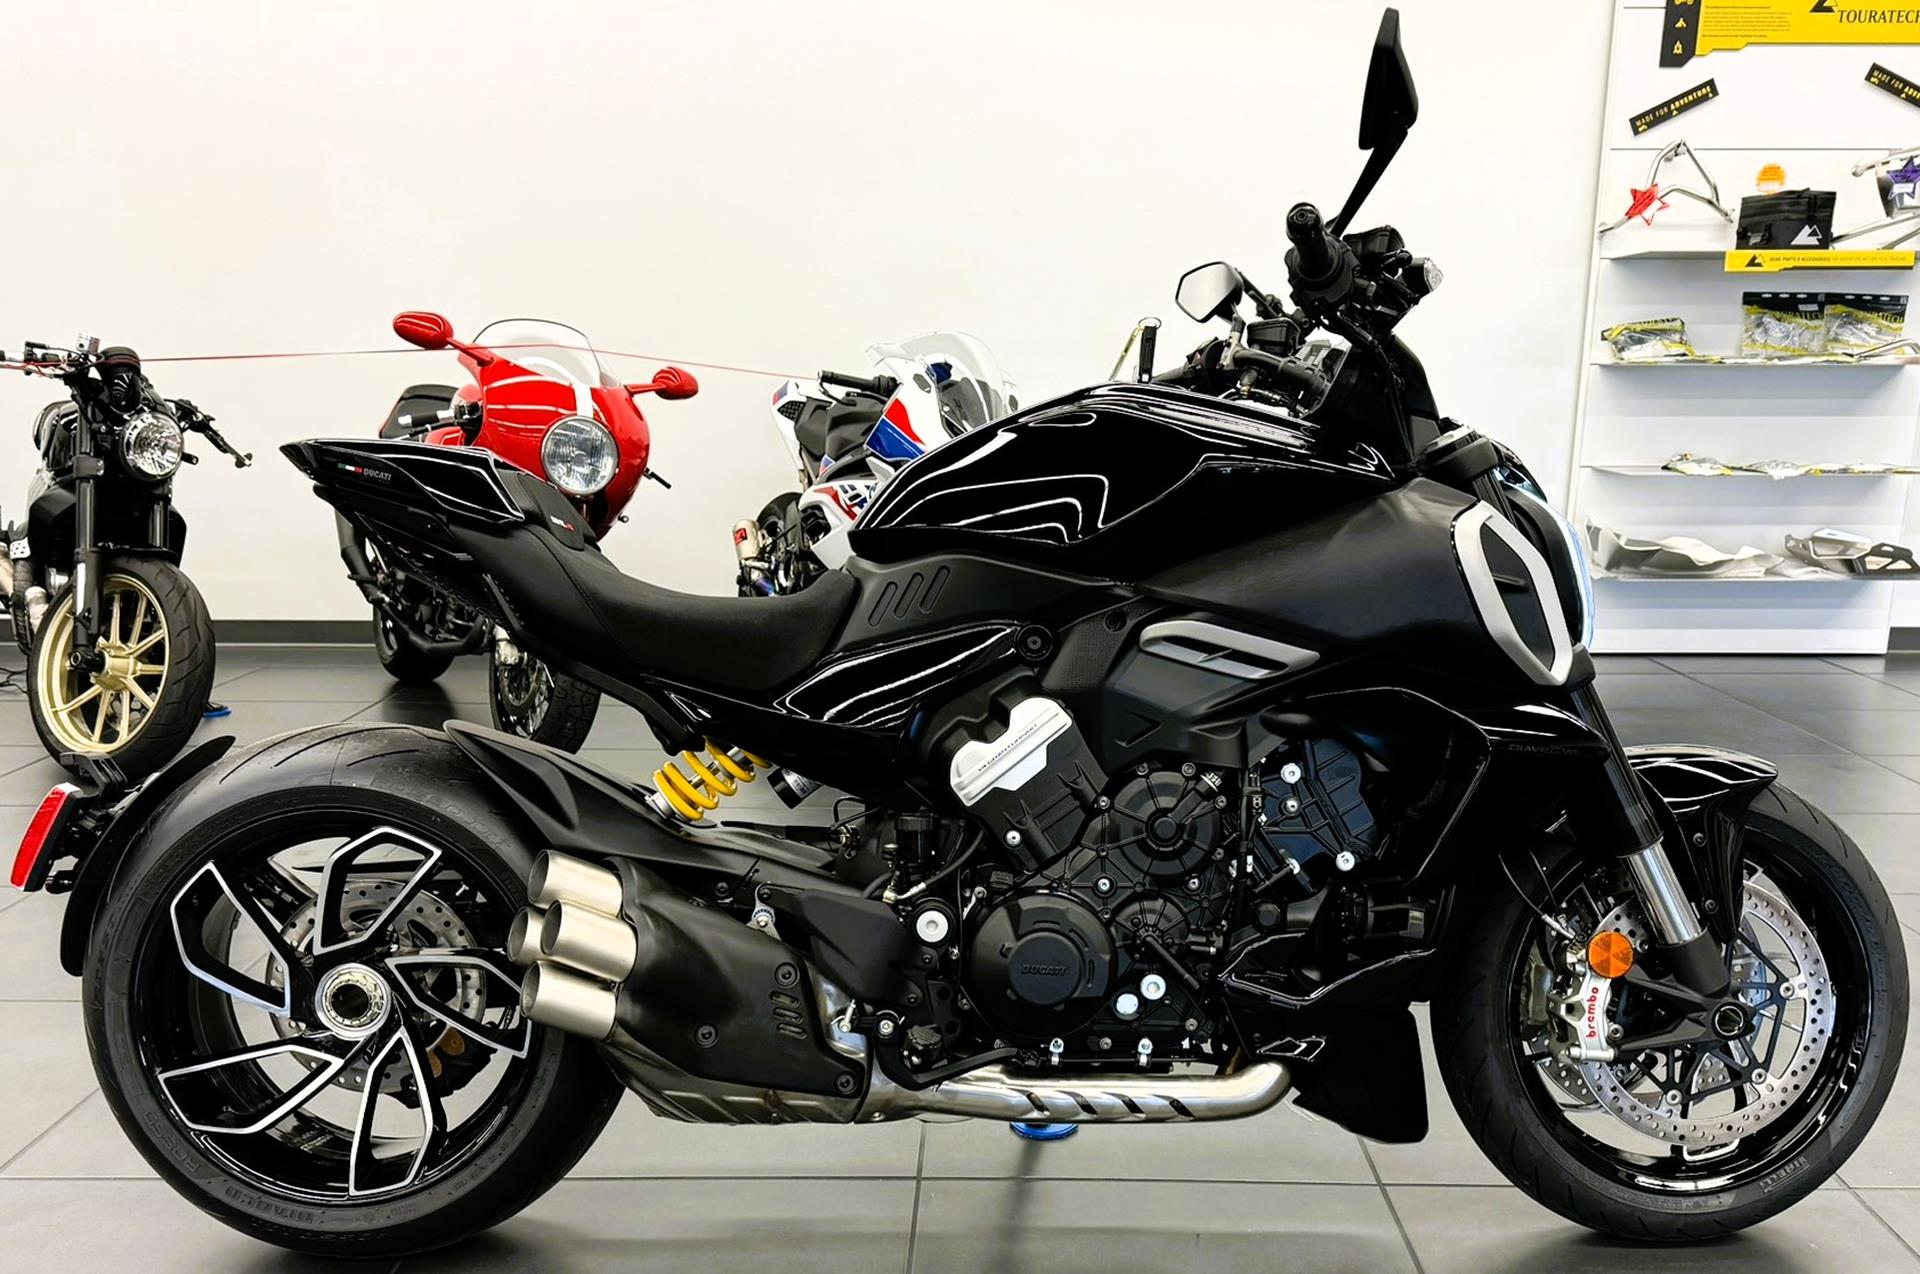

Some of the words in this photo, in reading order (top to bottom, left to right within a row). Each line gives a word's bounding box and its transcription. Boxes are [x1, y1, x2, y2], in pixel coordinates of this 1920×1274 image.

[363, 467, 392, 481] DUCATI
[1021, 963, 1067, 977] DUCATI
[1586, 986, 1599, 1039] brembo
[1760, 1156, 1809, 1192] PIRELLI
